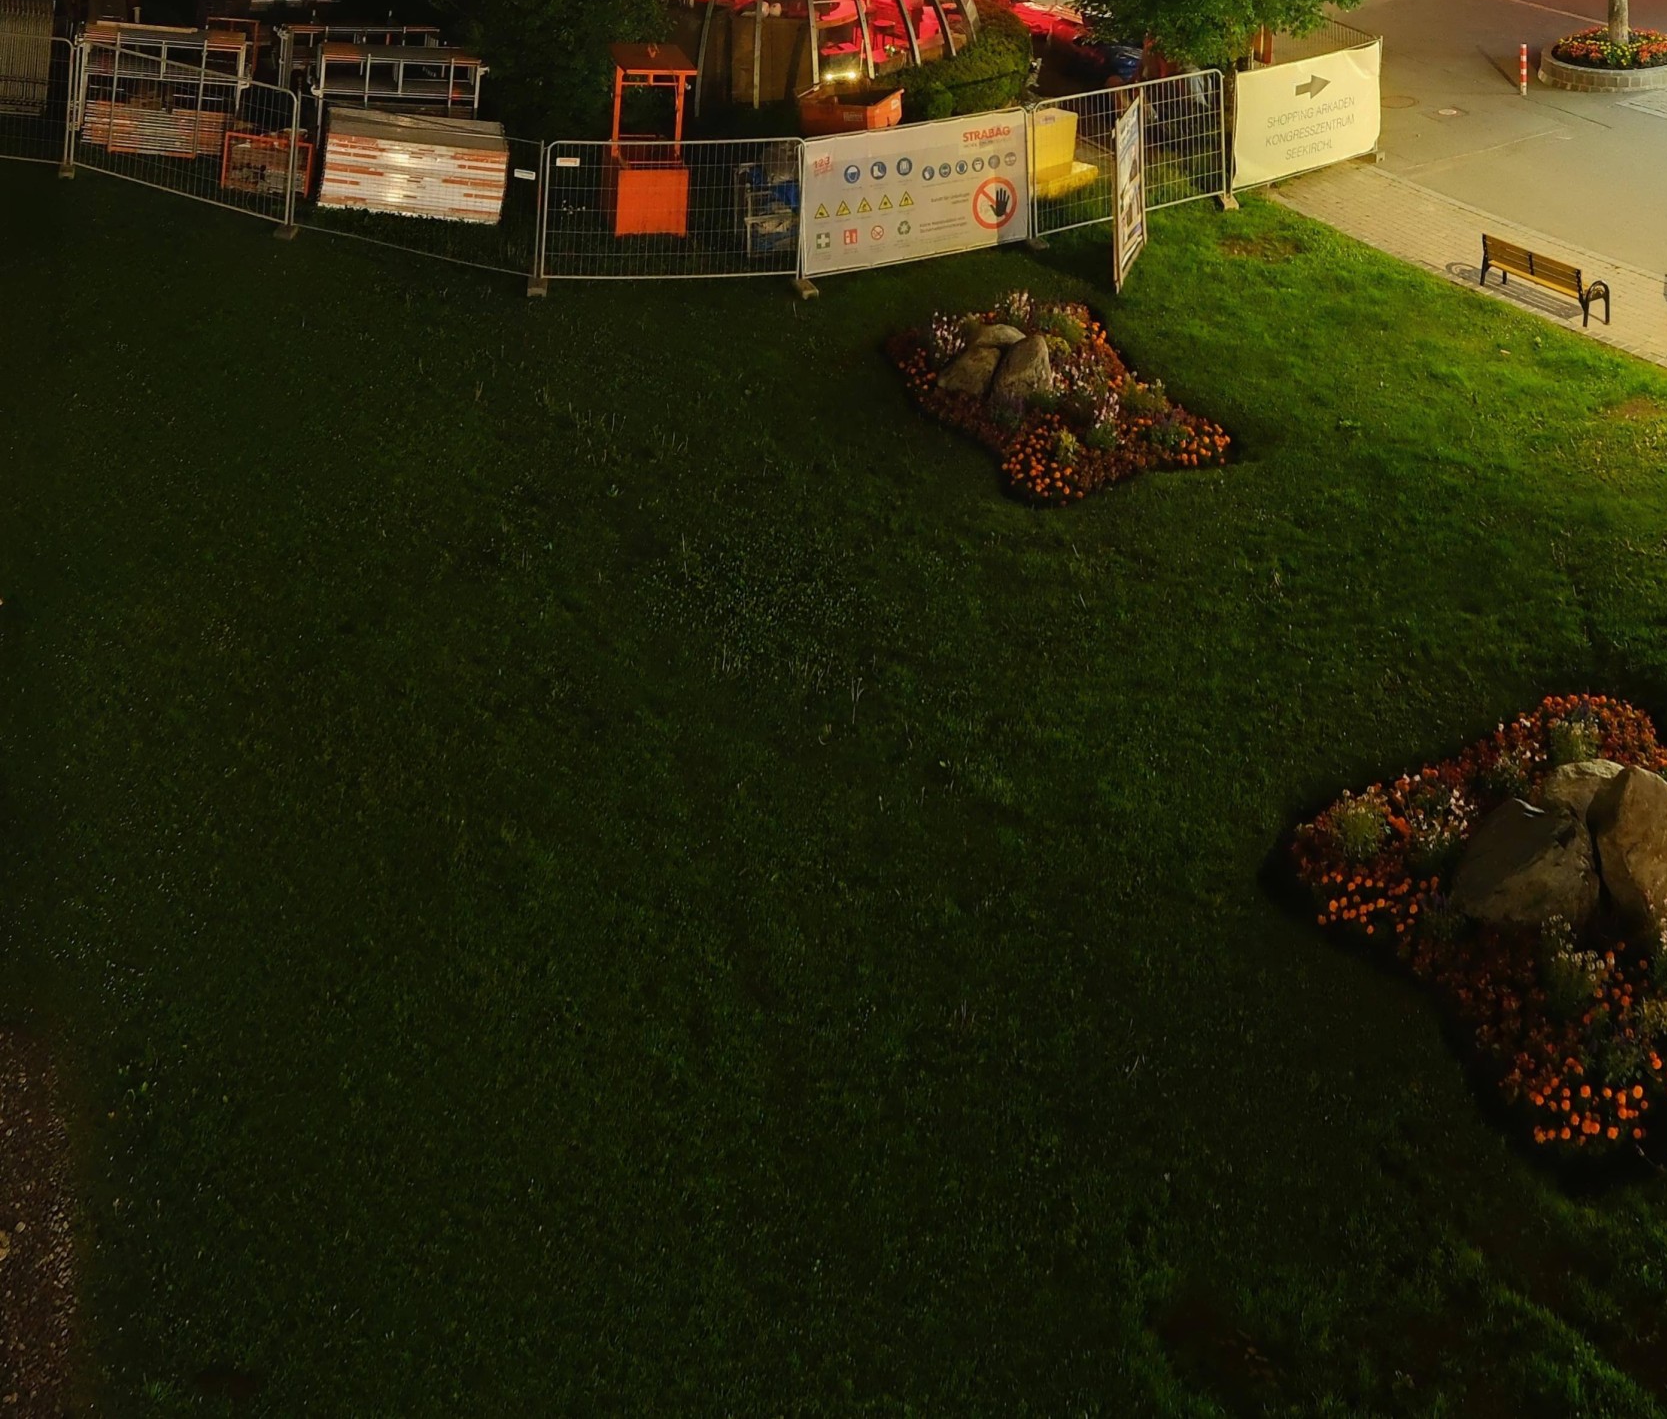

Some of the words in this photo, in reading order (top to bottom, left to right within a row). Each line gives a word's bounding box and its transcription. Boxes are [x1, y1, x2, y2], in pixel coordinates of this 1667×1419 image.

[1267, 107, 1314, 129] SHOPPING
[1315, 96, 1355, 116] ARKADEN
[963, 125, 1011, 143] STRABAG
[1265, 113, 1355, 148] KONGRESSZENTRUM
[1285, 138, 1333, 160] SEEKIRCHL
